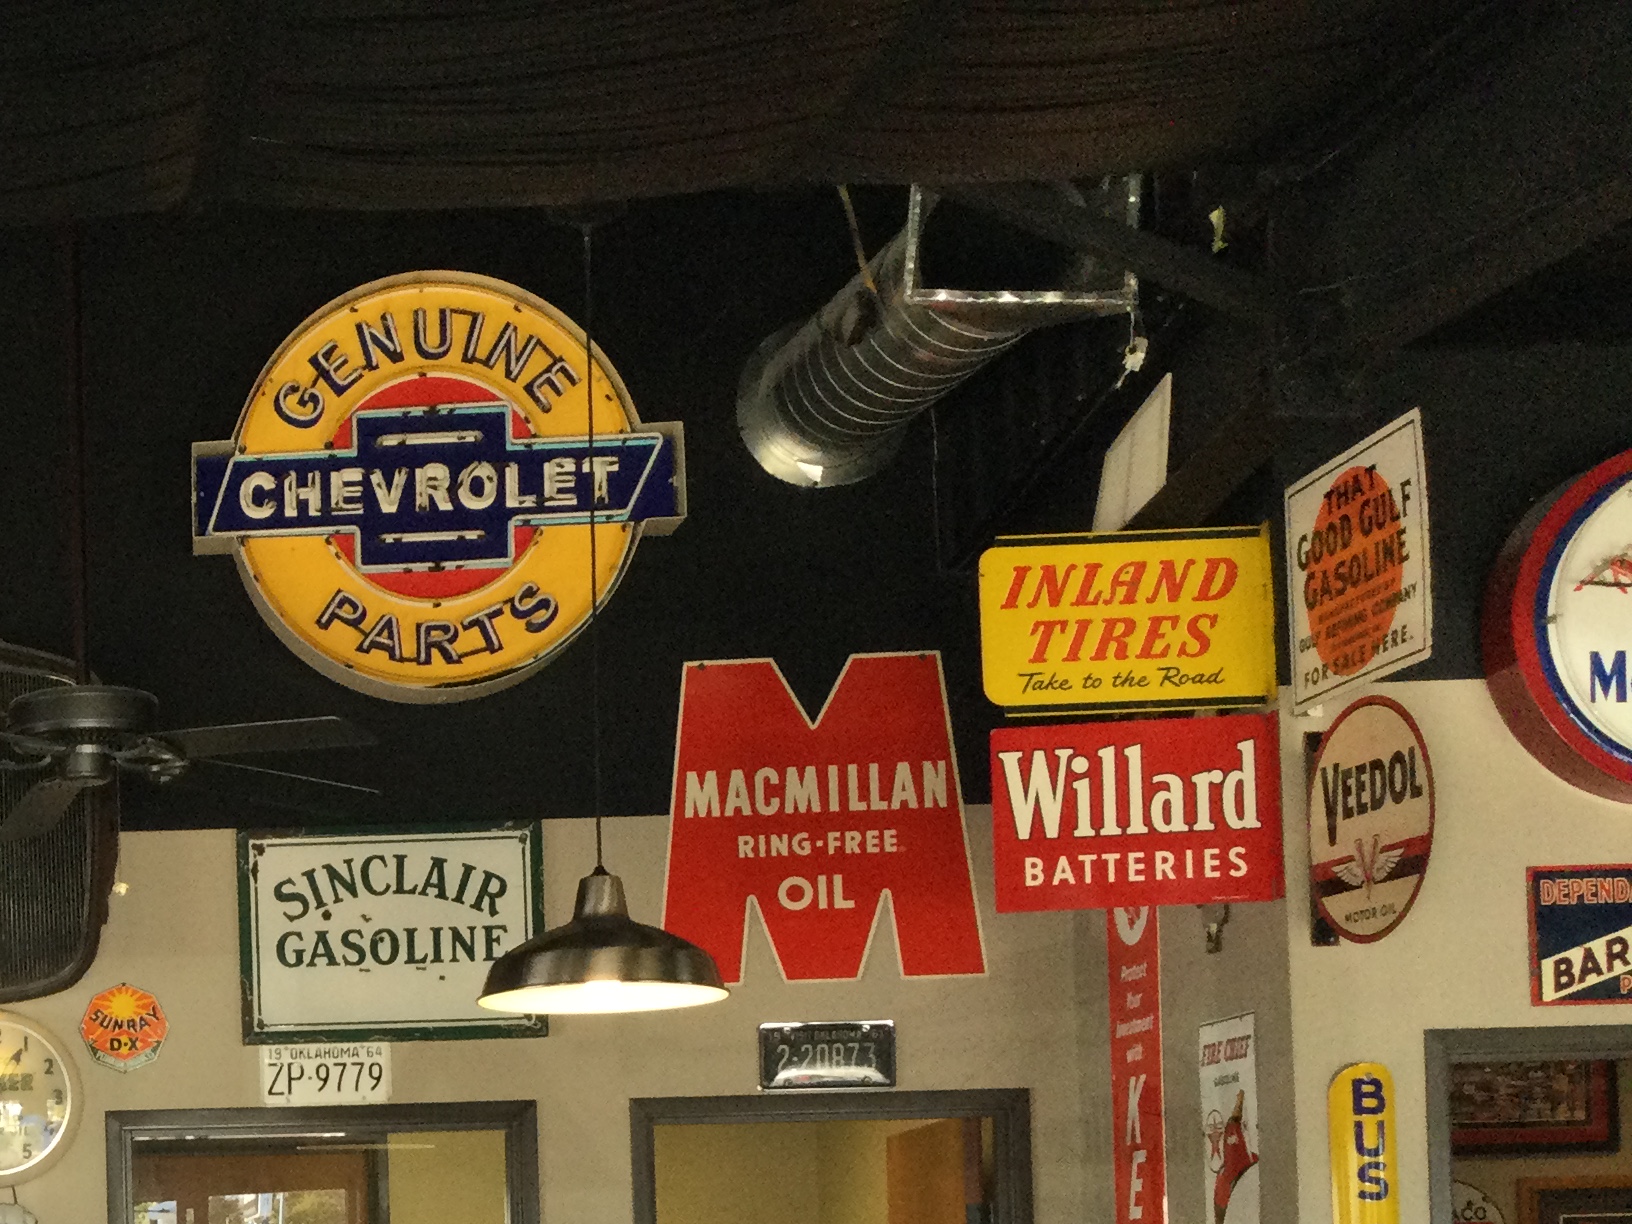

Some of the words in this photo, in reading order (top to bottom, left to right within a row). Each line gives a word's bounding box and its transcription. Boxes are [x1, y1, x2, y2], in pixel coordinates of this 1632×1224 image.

[273, 307, 583, 428] GENUINE
[239, 456, 621, 519] CHEVROLET
[1324, 464, 1377, 516] THAT
[1297, 514, 1353, 572] GOOD
[1359, 478, 1412, 537] GULF
[1000, 557, 1239, 610] INLAND
[1304, 527, 1410, 612] GASOLINE
[315, 581, 559, 666] PARTS
[1027, 613, 1218, 664] TIRES
[1018, 671, 1073, 694] Take
[1081, 673, 1103, 690] to
[1111, 670, 1151, 689] the
[1156, 666, 1226, 688] Road
[1304, 662, 1329, 690] FOR
[1589, 650, 1632, 703] M
[684, 760, 948, 819] MACMILLAN
[997, 738, 1262, 841] Willard
[1320, 746, 1423, 846] VEEDOL
[737, 829, 899, 858] RING-FREE
[1024, 846, 1249, 888] BATTERIES
[273, 854, 508, 922] SINCLAIR
[778, 874, 856, 911] OIL
[1540, 878, 1632, 905] DEPEND
[276, 925, 509, 968] GASOLINE
[89, 1005, 160, 1033] SUNRAY
[290, 1046, 360, 1060] OKLAHOMA
[1352, 1077, 1389, 1202] BUS
